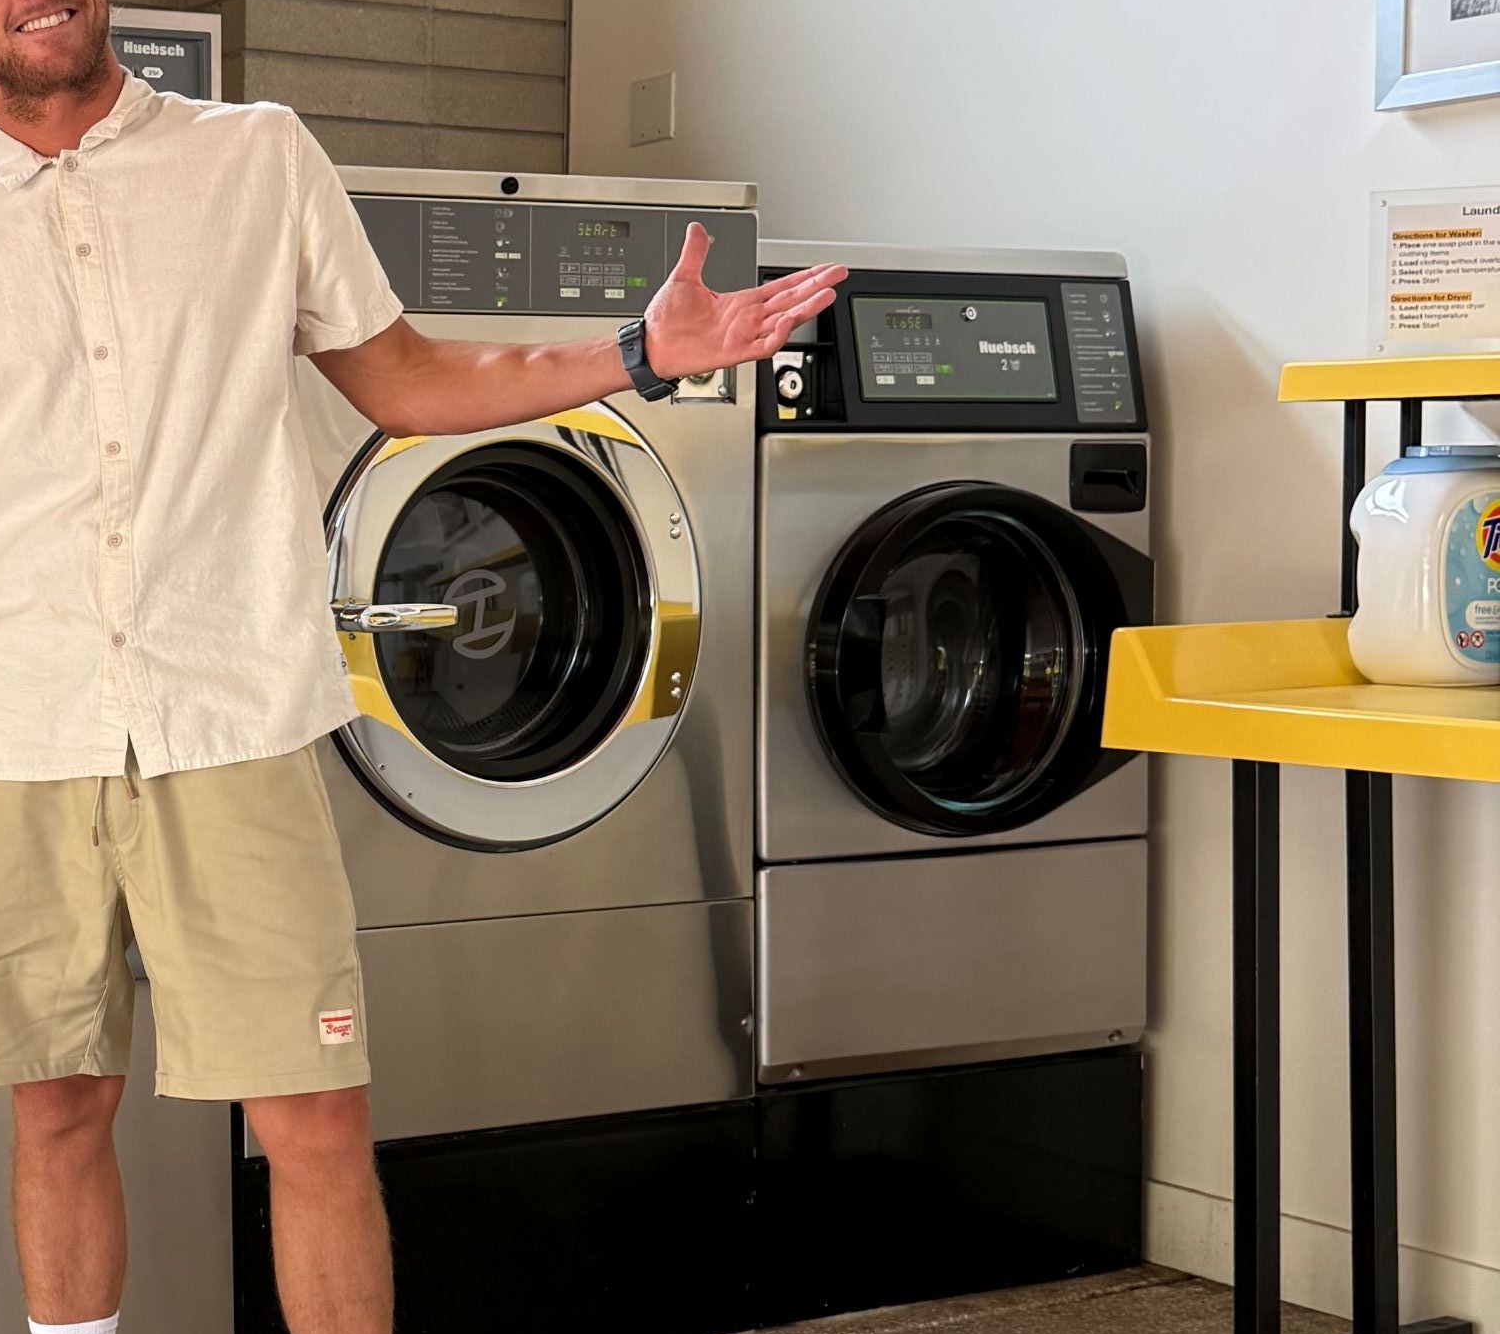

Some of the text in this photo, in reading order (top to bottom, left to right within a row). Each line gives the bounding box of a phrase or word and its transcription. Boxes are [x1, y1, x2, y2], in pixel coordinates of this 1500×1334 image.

[123, 41, 185, 56] Huebsch
[1462, 206, 1500, 216] Laund
[1392, 232, 1434, 240] Directions
[1458, 239, 1473, 248] pod
[1419, 259, 1449, 267] clothing
[1424, 268, 1443, 276] cycle
[1390, 295, 1432, 303] Directions
[1419, 304, 1449, 312] clothing
[979, 340, 1036, 354] Huebsch
[1001, 358, 1008, 371] 2
[1474, 604, 1492, 615] free
